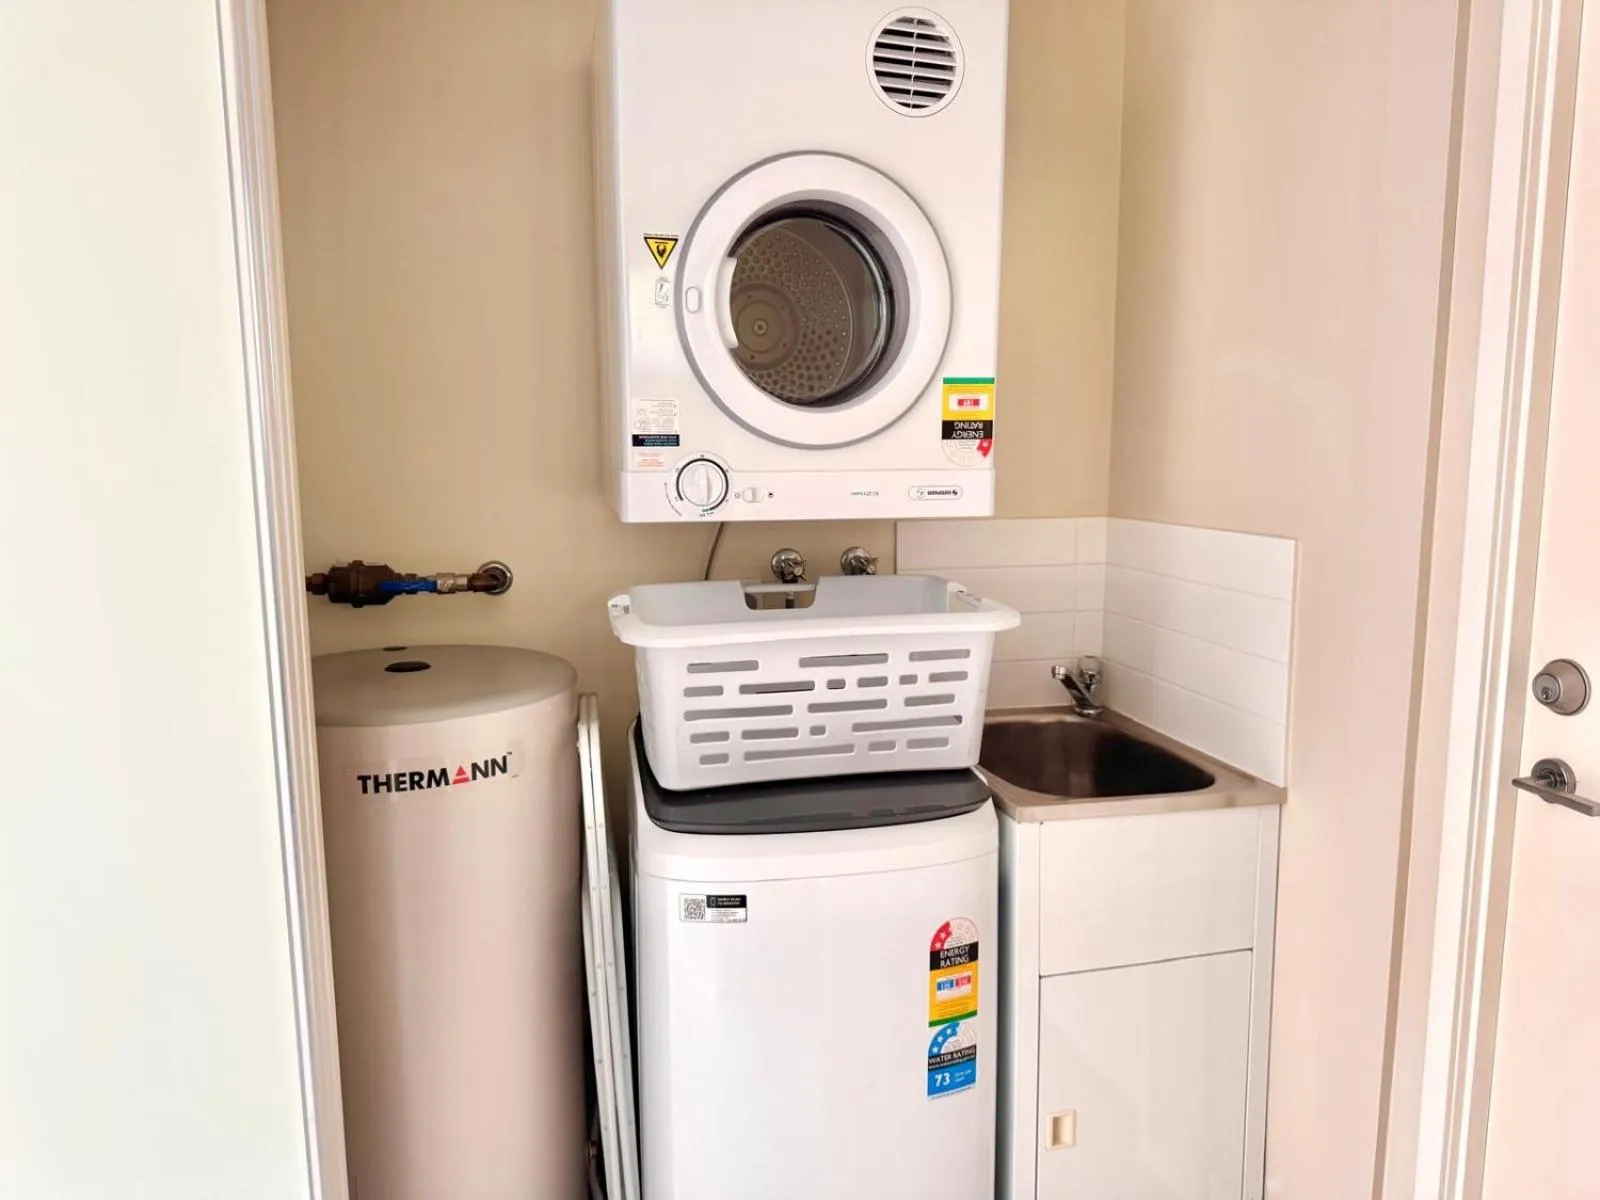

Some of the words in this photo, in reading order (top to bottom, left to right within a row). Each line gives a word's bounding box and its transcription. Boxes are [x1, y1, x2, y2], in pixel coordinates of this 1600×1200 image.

[954, 421, 984, 430] RATING
[952, 430, 984, 439] ENERGY
[939, 945, 970, 959] ENERGY
[940, 955, 970, 968] RATING
[928, 1053, 952, 1065] WATER
[934, 1072, 951, 1088] 73
